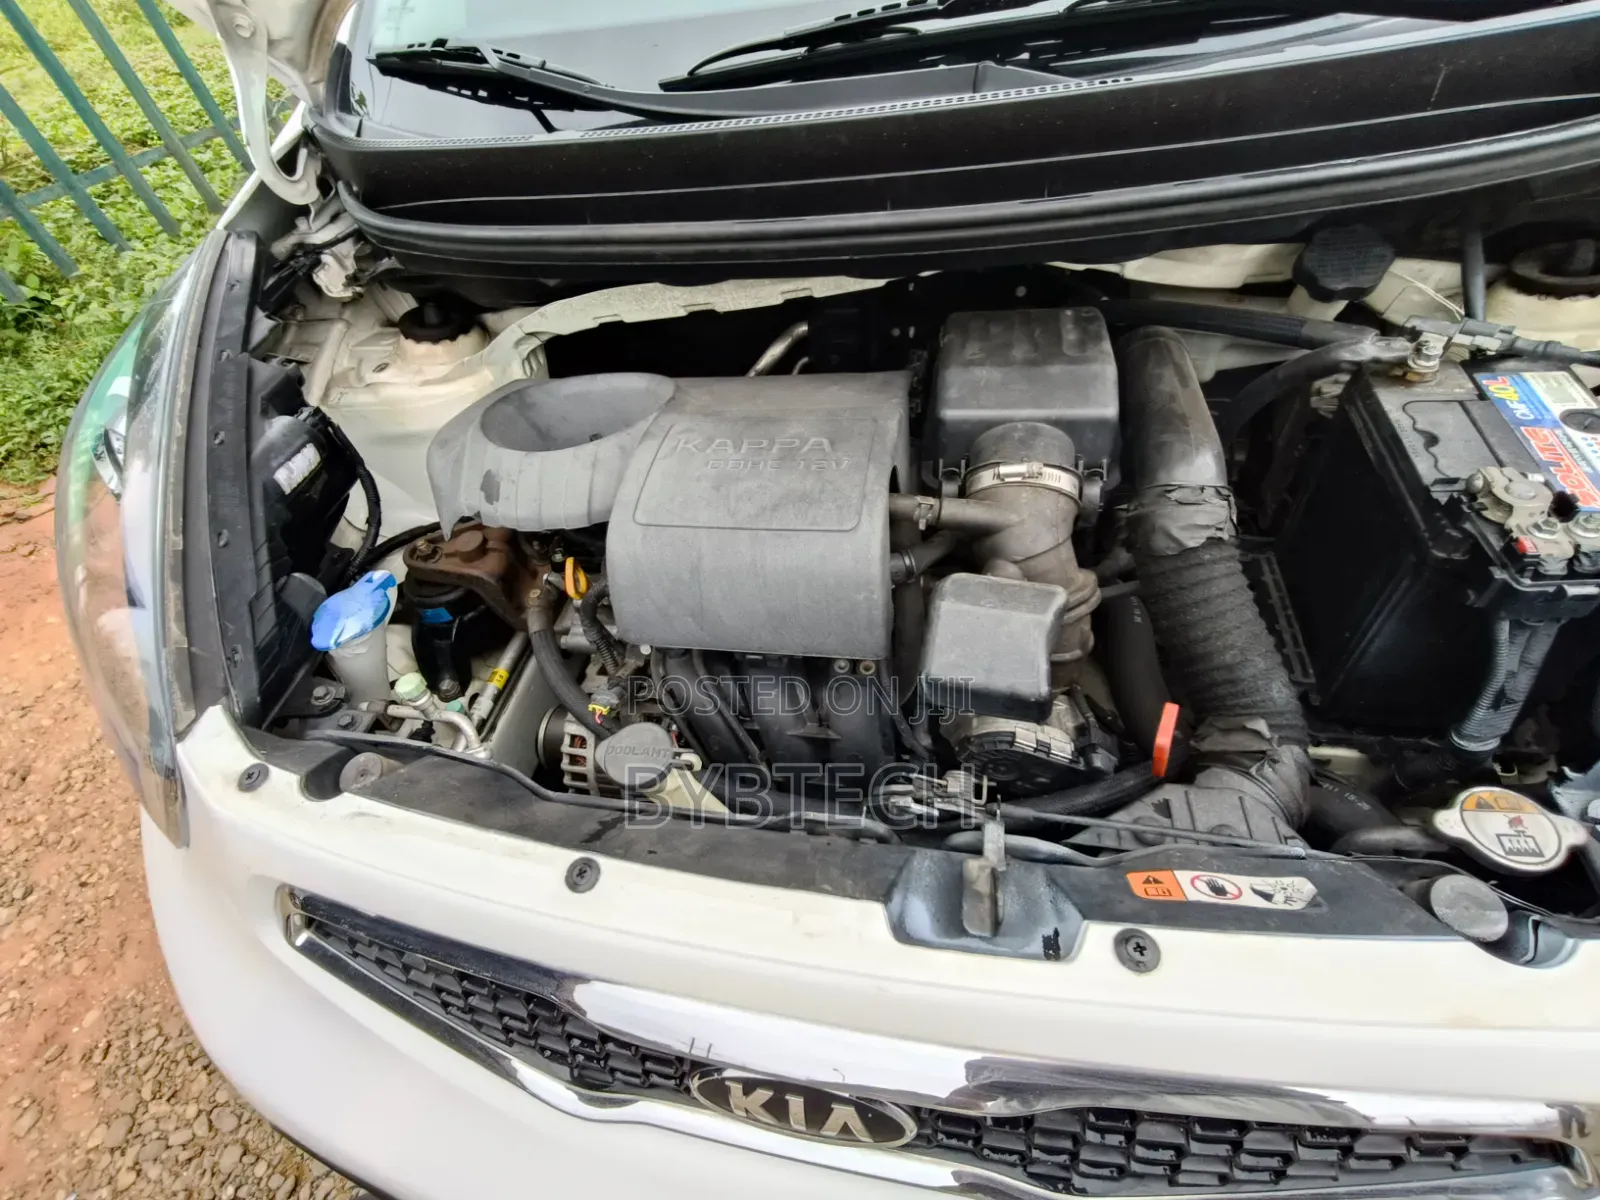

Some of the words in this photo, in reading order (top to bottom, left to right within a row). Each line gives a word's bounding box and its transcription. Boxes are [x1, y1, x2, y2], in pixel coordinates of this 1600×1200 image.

[675, 436, 833, 454] KAPPA
[1520, 426, 1600, 507] SOLITE
[725, 1080, 874, 1143] KIA
